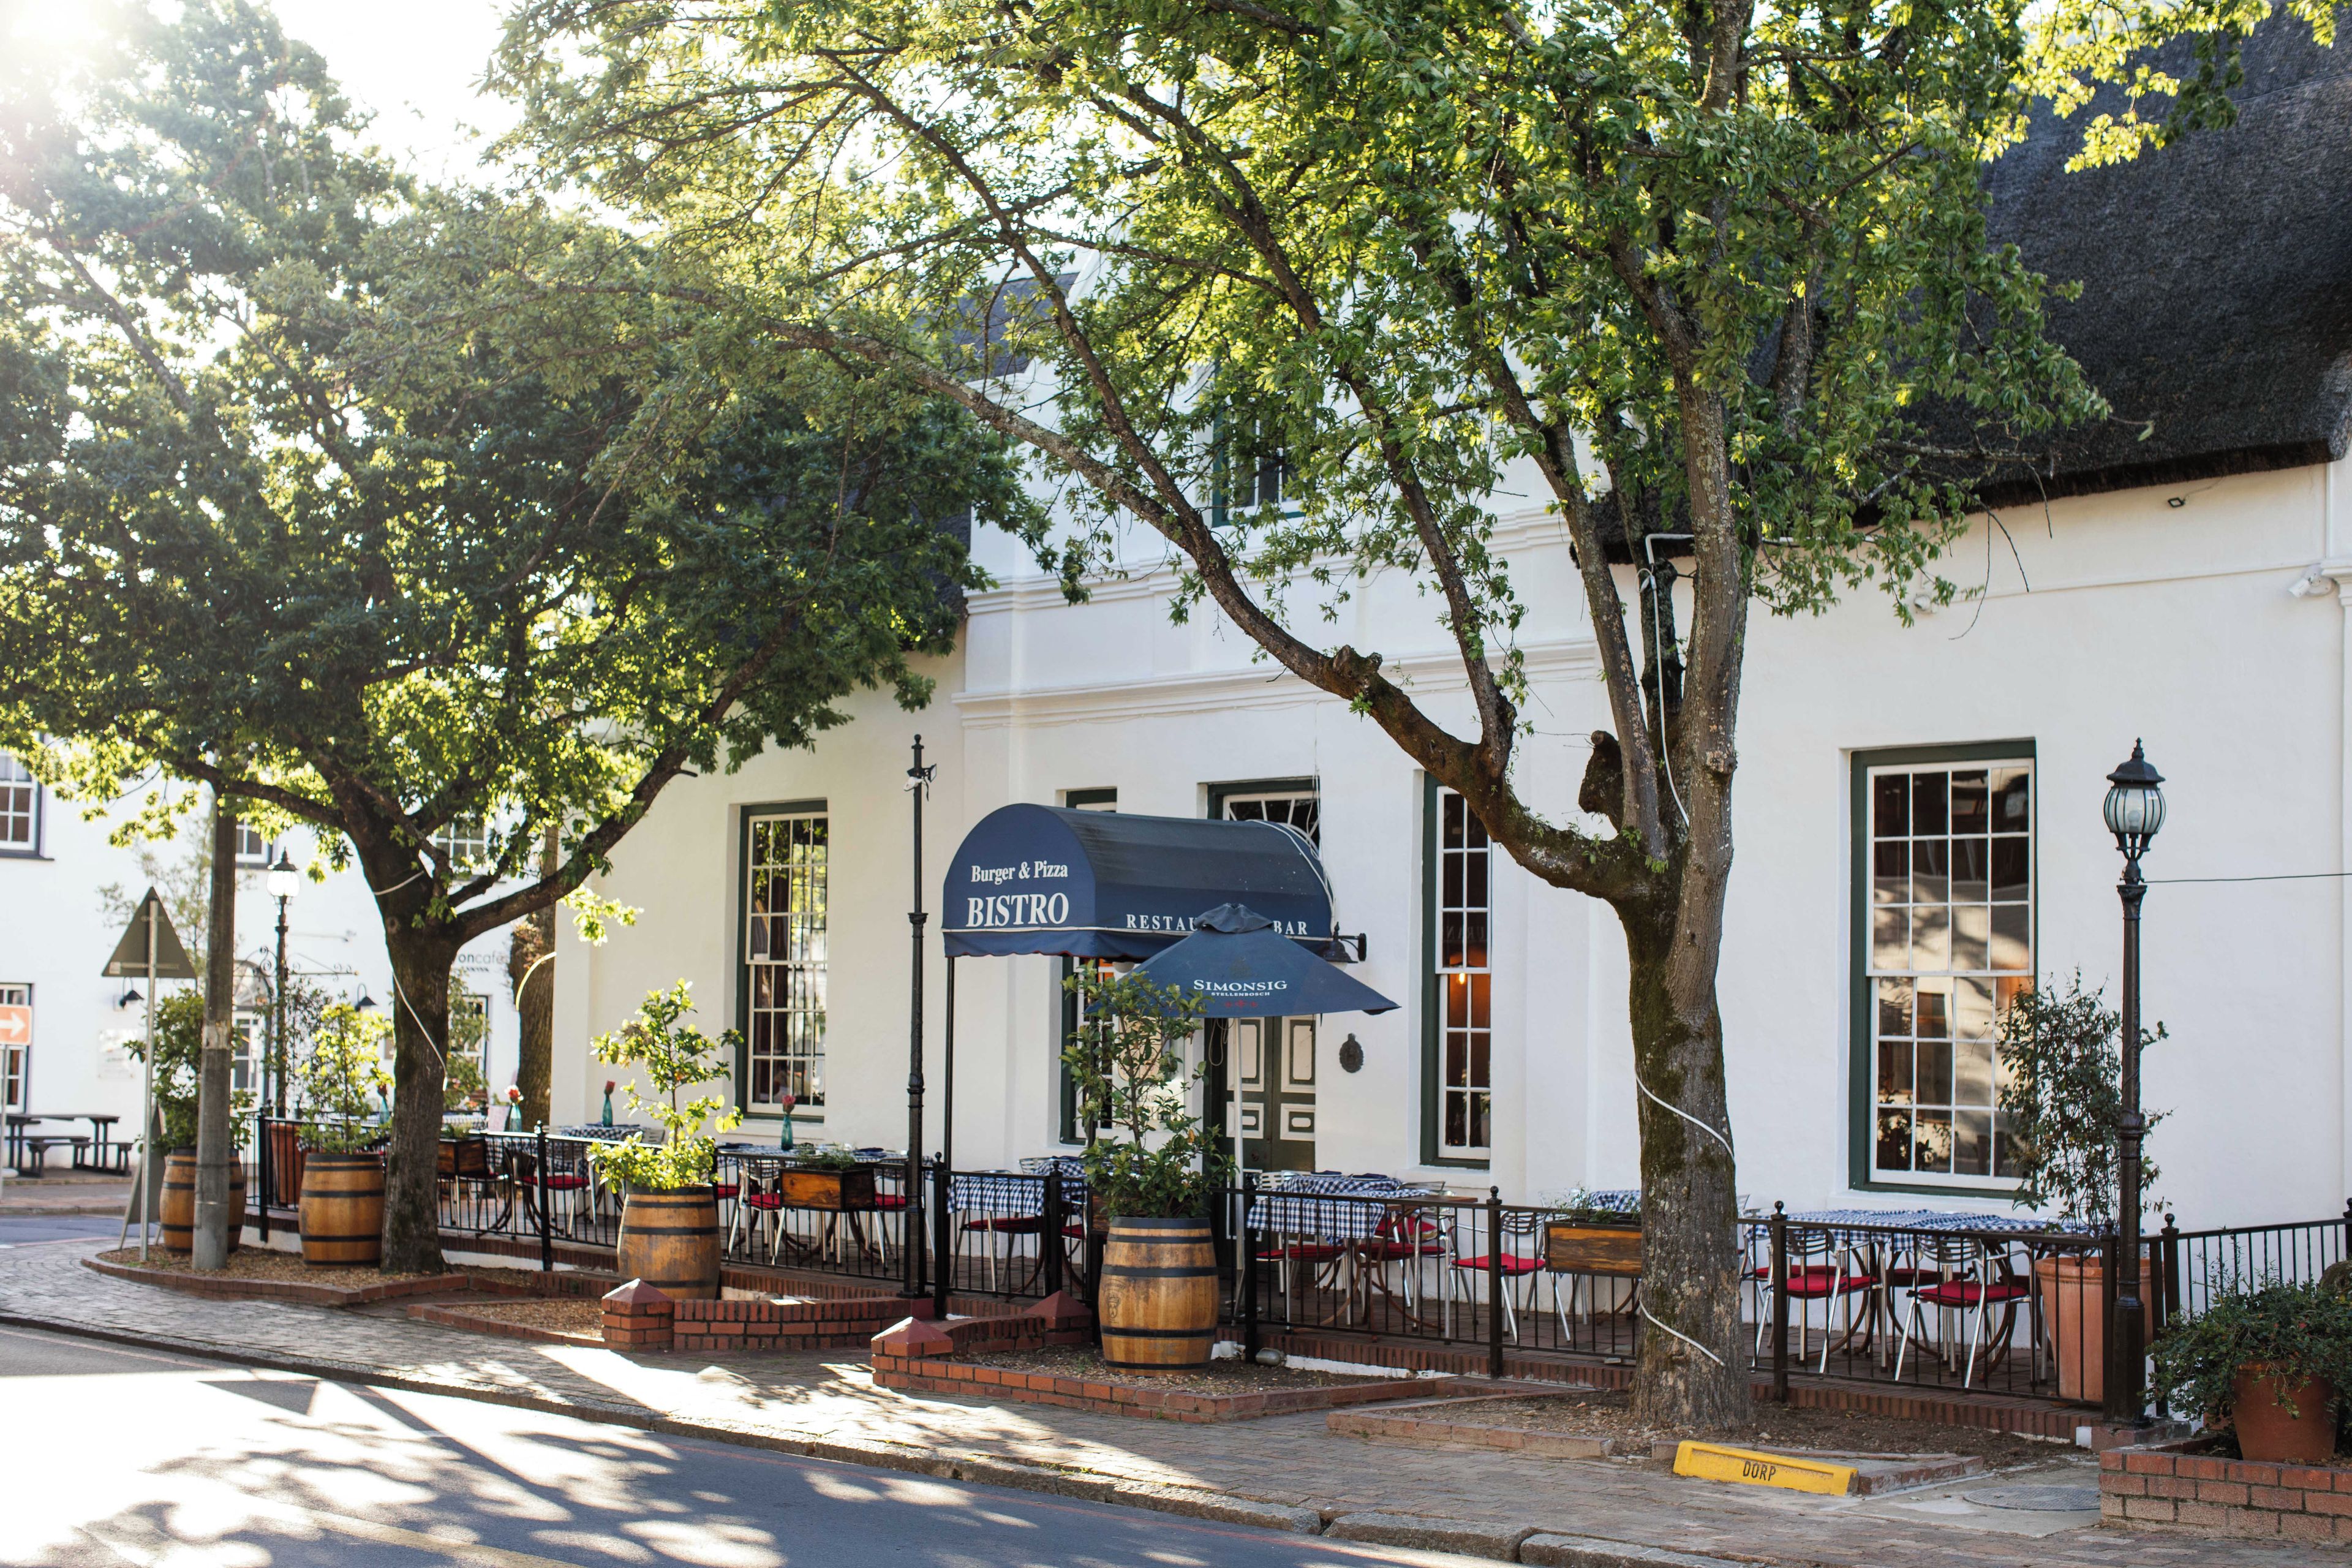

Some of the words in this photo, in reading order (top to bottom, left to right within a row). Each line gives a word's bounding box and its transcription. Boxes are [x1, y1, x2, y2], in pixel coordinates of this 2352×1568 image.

[971, 865, 1016, 885] Burger
[1019, 861, 1030, 880] &
[1034, 860, 1068, 878] Pizza
[965, 892, 1069, 927] BISTRO
[1126, 914, 1198, 931] RESTAU
[1273, 920, 1308, 935] BAR
[1194, 979, 1287, 992] SIMONSIG
[1743, 1460, 1776, 1481] DORP
